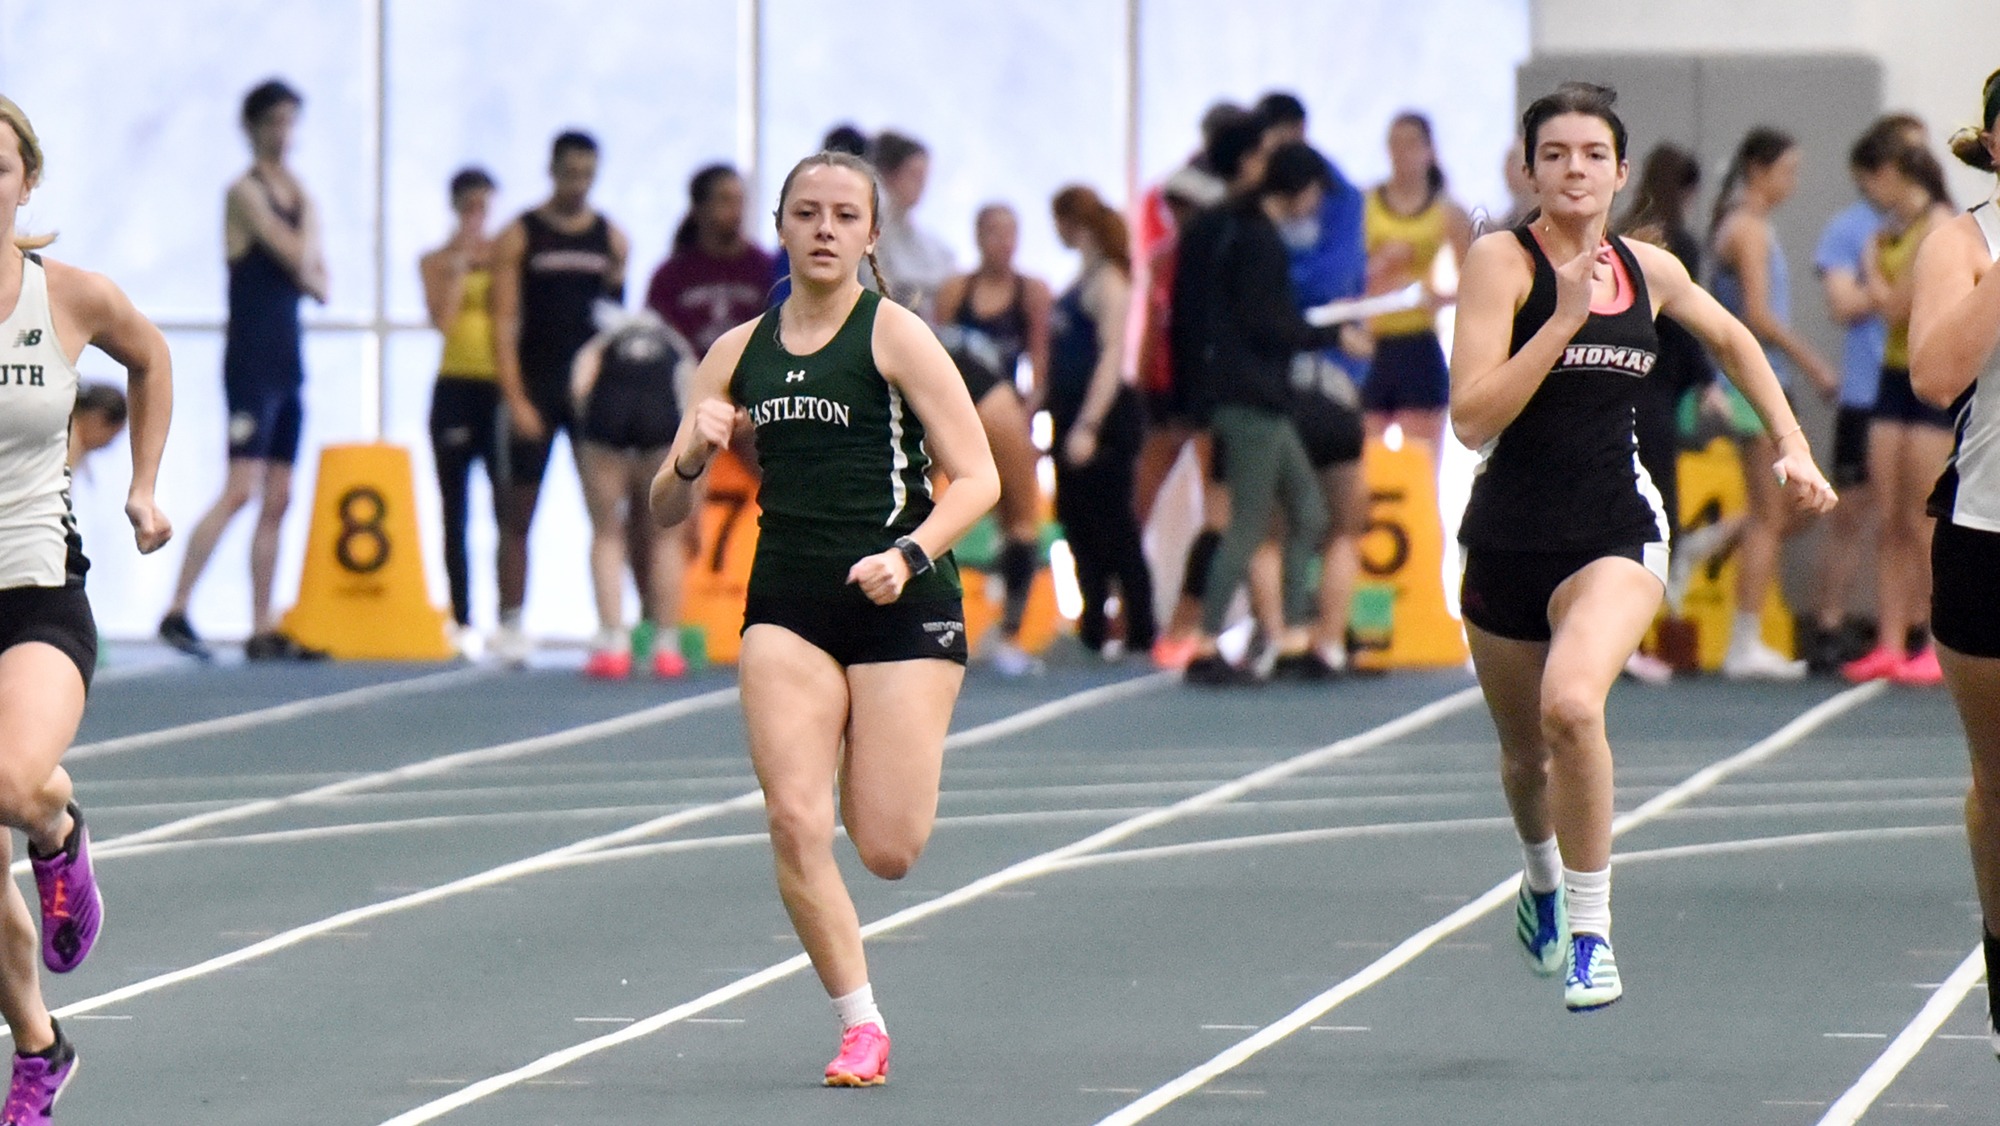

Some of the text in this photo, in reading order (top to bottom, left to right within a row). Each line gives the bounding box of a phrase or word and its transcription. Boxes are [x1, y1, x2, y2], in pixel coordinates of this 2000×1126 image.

[748, 396, 850, 429] ASTLETON
[336, 485, 391, 574] 8
[705, 489, 748, 574] 7
[1361, 488, 1410, 577] 5
